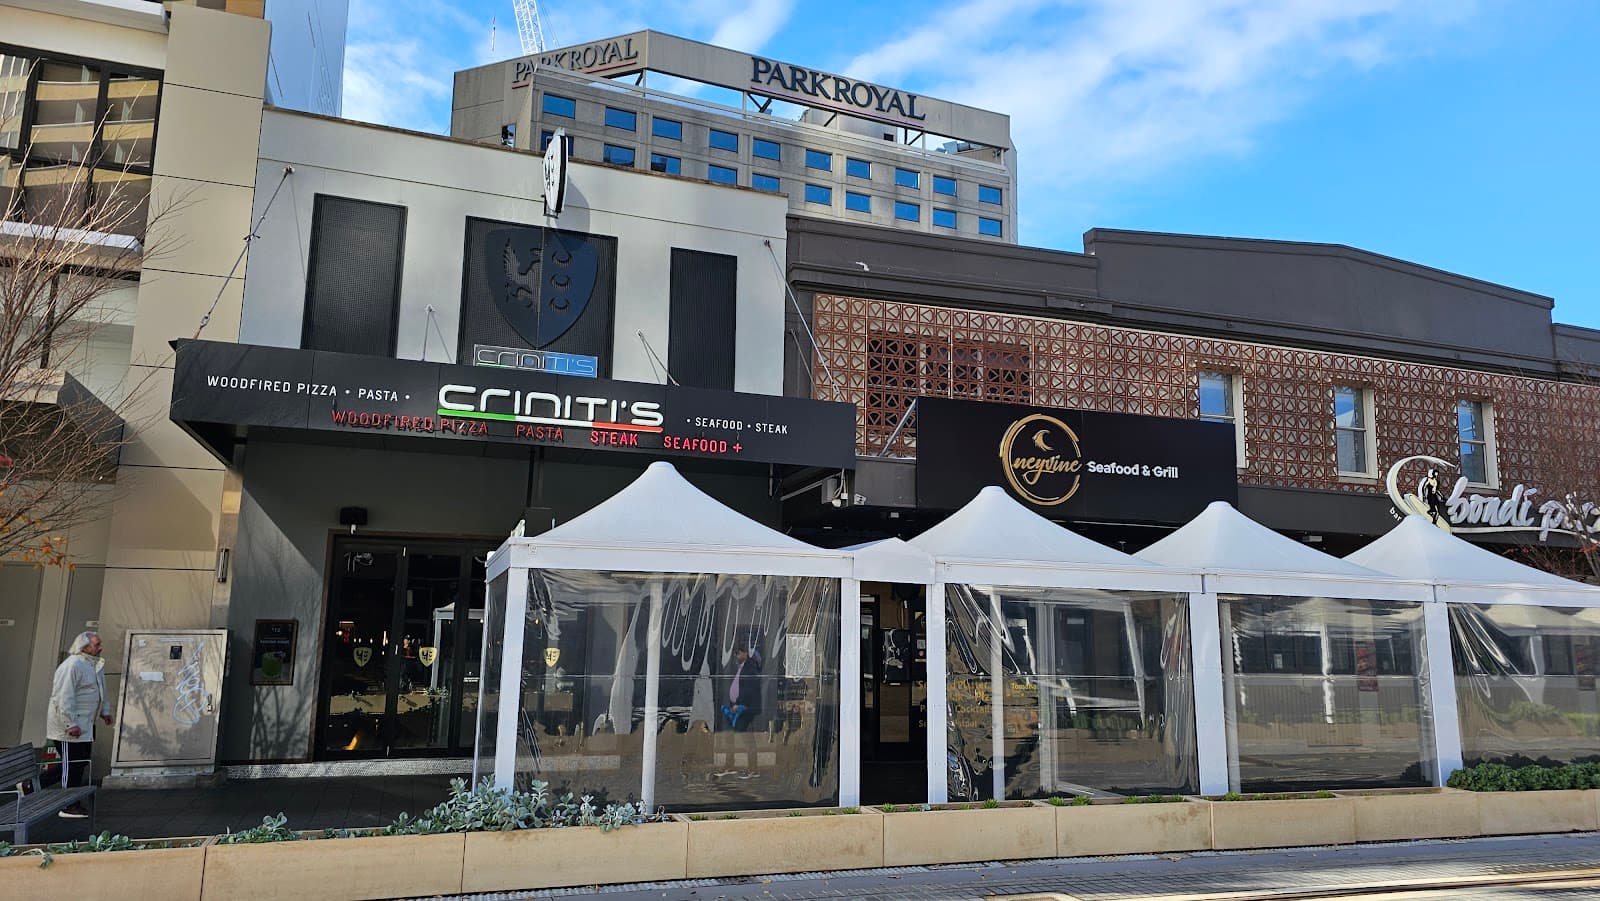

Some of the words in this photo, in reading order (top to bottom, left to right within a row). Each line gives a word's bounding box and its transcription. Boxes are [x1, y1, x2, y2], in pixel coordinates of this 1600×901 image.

[751, 56, 926, 121] PARKROYAL
[206, 375, 292, 393] WOODFIRED
[296, 382, 337, 397] PIZZA
[358, 388, 399, 402] PASTA
[331, 409, 434, 431] WOODFIRED
[439, 418, 488, 434] PIZZA
[515, 424, 564, 441] PASTA
[590, 430, 638, 446] STEAK
[663, 436, 728, 453] SEAFOOD
[695, 416, 743, 431] SEAFOOD
[755, 422, 788, 435] STEAK
[1087, 460, 1140, 476] Seafood
[1142, 465, 1151, 477] &
[1152, 466, 1180, 479] Grill
[1389, 506, 1402, 522] bar
[1445, 476, 1538, 527] bondi
